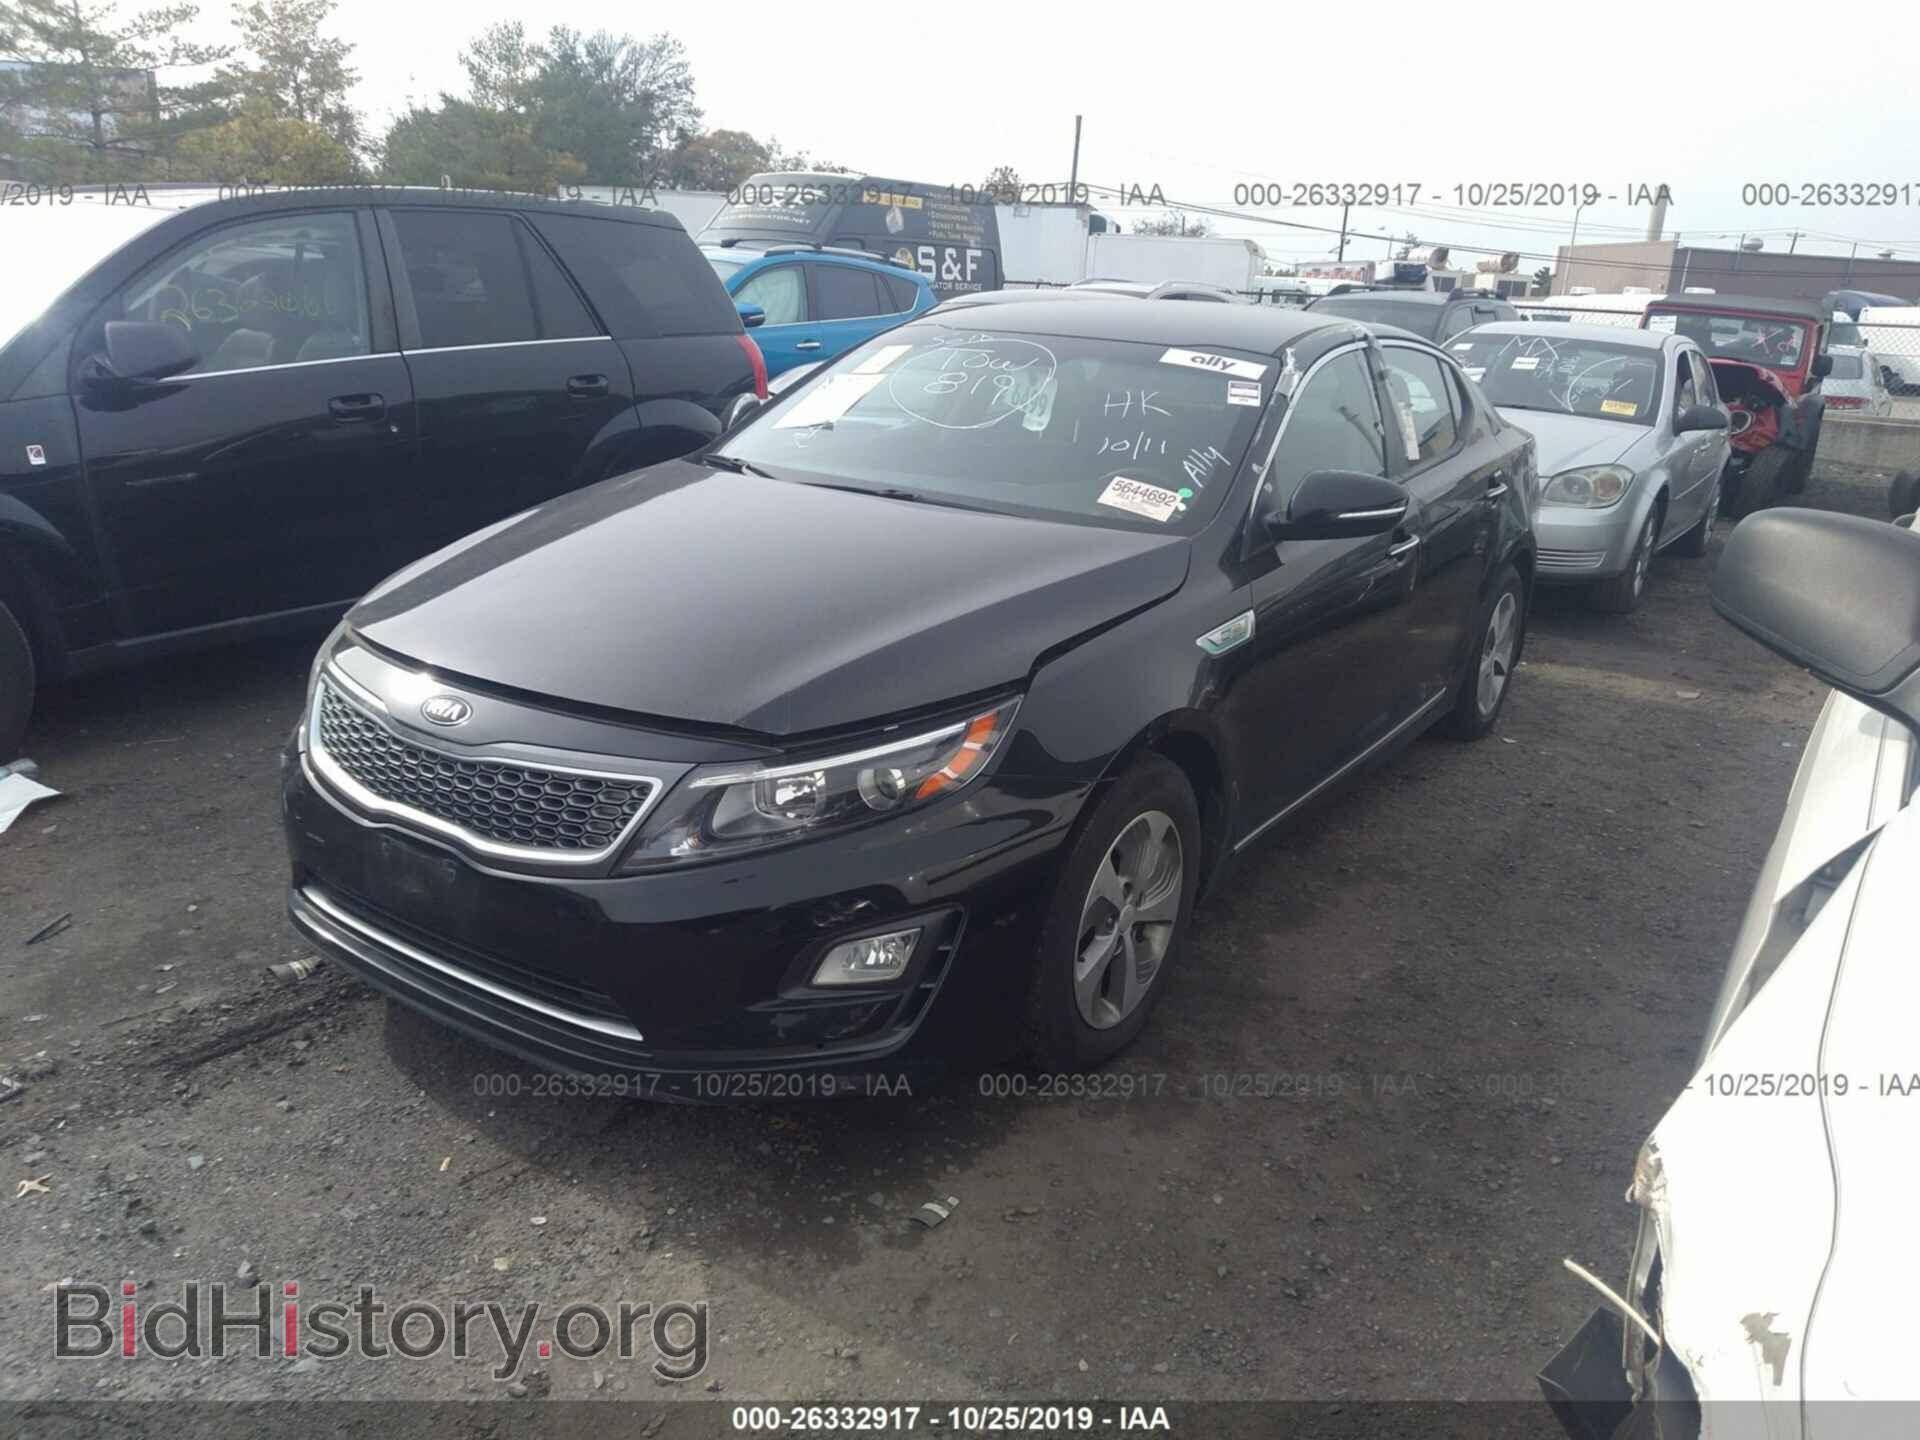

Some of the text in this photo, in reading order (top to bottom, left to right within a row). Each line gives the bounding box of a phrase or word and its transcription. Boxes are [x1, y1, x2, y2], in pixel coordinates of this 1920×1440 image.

[1190, 355, 1236, 371] ally
[923, 372, 1015, 405] 819
[1104, 390, 1173, 418] HK
[1097, 432, 1166, 460] 10/11
[1183, 446, 1231, 487] Ally
[1112, 480, 1177, 507] 5644692
